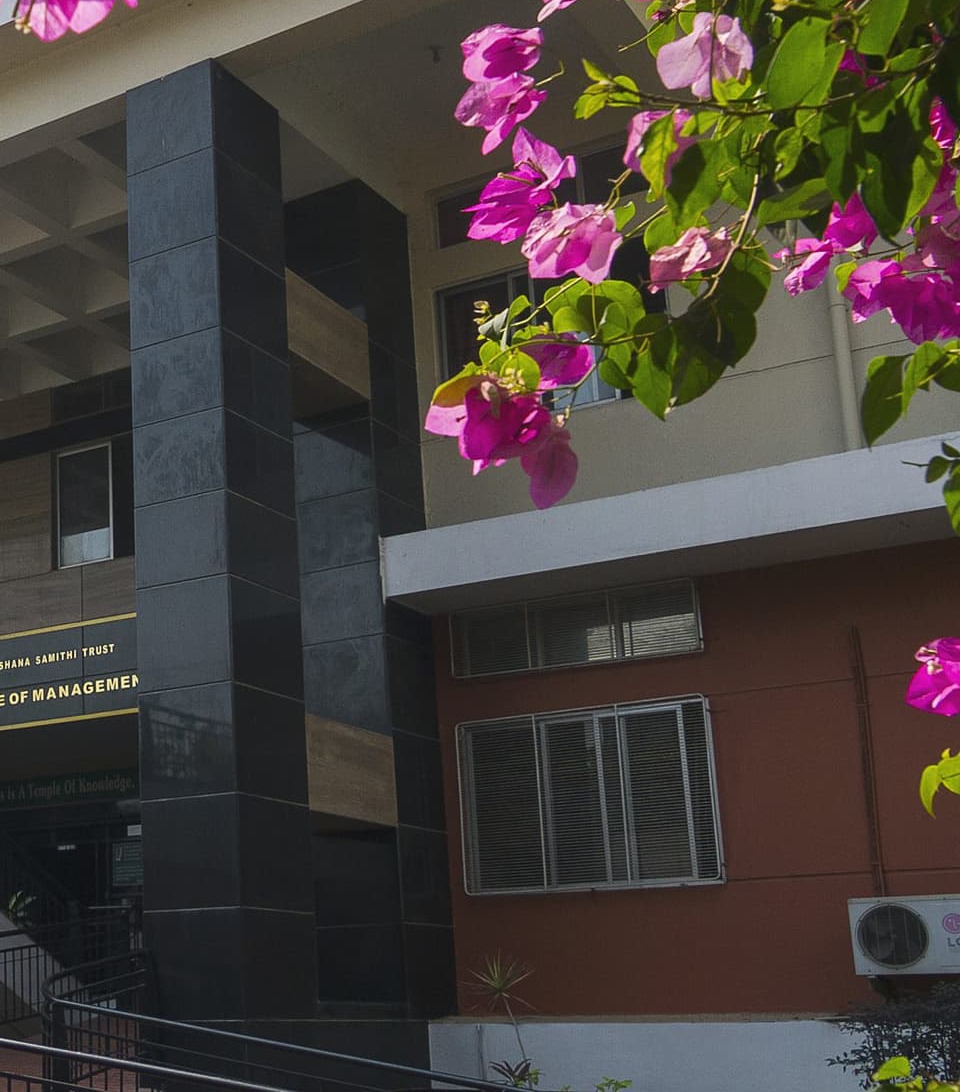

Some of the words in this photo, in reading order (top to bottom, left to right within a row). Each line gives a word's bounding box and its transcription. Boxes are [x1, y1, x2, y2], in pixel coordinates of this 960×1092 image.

[35, 649, 78, 666] SAMITHI
[82, 643, 116, 658] TRUST
[9, 690, 29, 706] OF
[32, 674, 139, 702] MANAGEMEN
